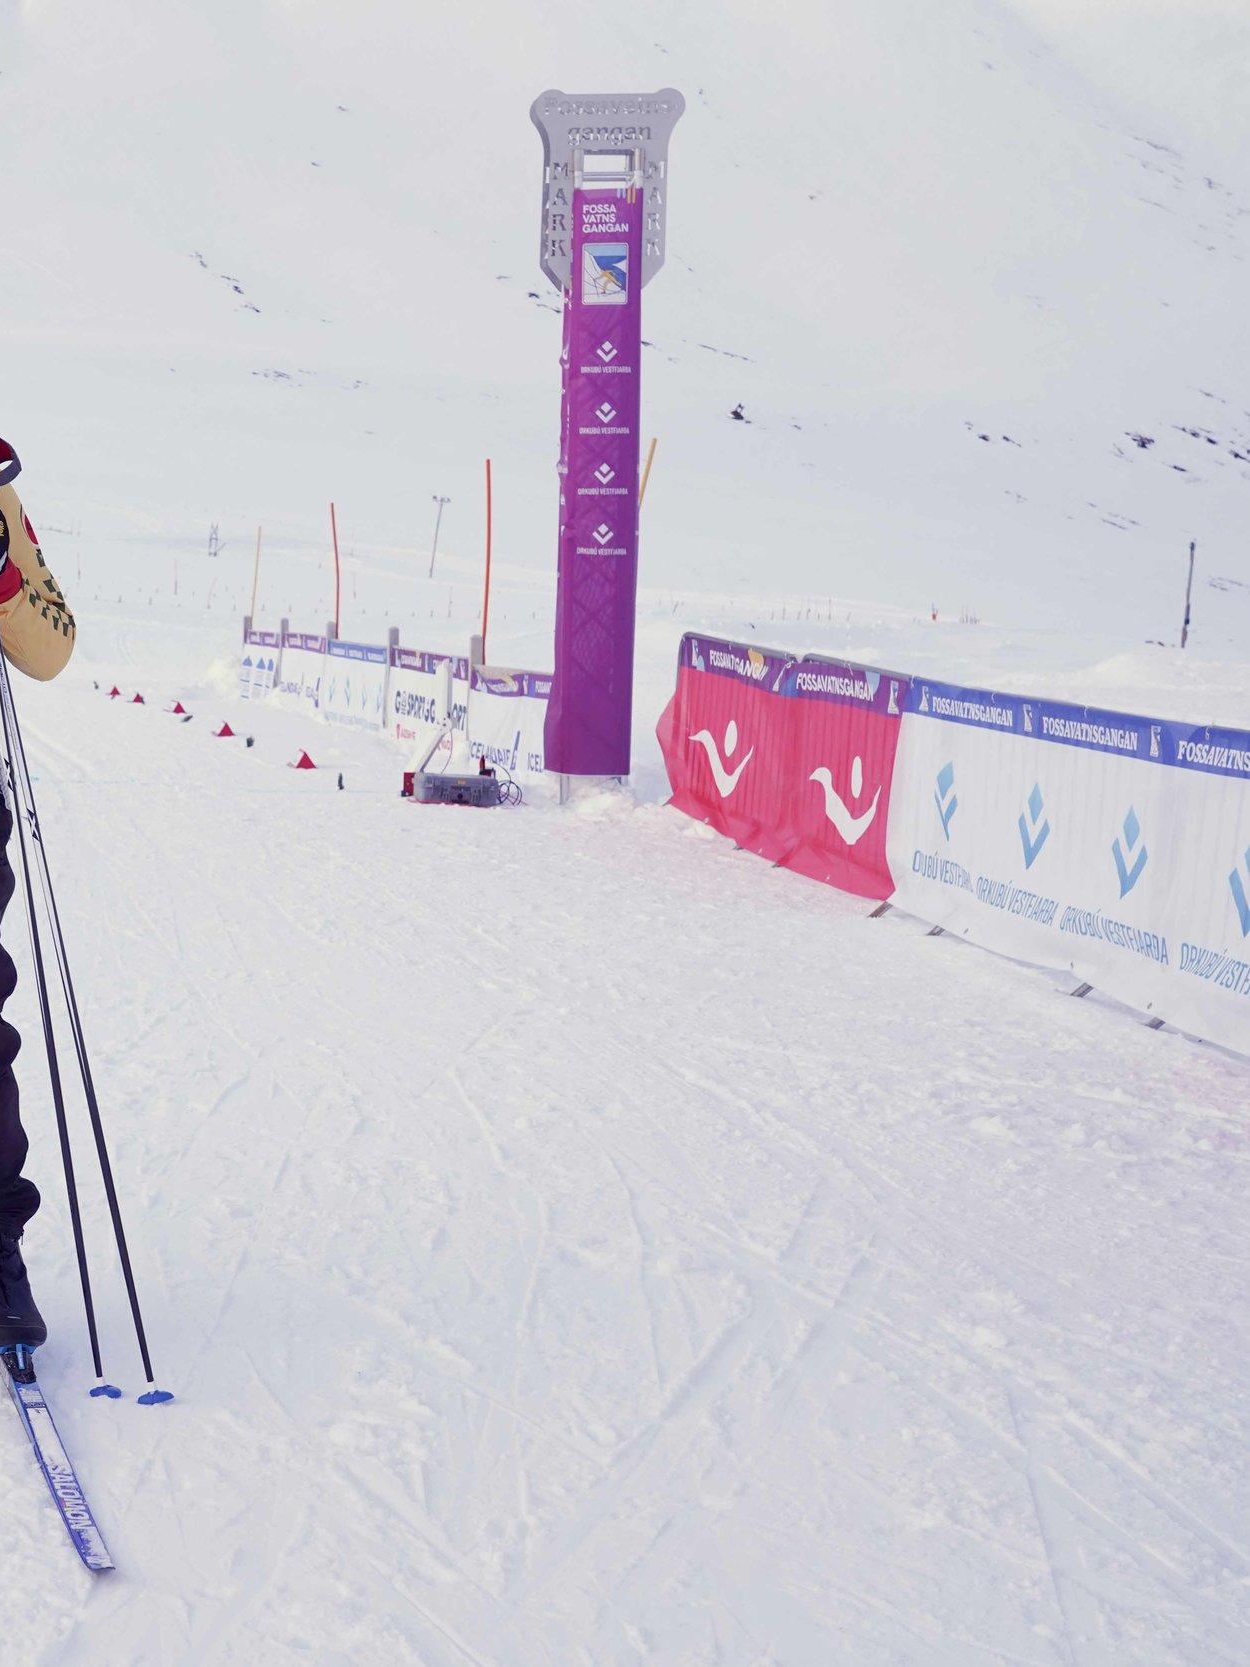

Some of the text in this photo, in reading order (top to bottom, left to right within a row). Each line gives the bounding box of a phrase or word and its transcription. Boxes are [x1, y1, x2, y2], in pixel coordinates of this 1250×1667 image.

[568, 125, 652, 146] gangan
[582, 203, 617, 214] FOSSA
[582, 213, 616, 223] VATNS
[582, 222, 629, 233] GANGAN
[796, 672, 874, 702] FOSSAVATNSGANGAN
[931, 695, 1013, 727] FOSSAVATNSGANGAN
[1042, 716, 1139, 751] FOSSAVATNSGANGAN
[1176, 740, 1250, 773] FOSSAVATNS
[976, 879, 1012, 910] ORKUBÚ
[1060, 906, 1169, 966] ORKUBÚ VESTFJARÐA
[1180, 942, 1228, 980] ORKUBÚ
